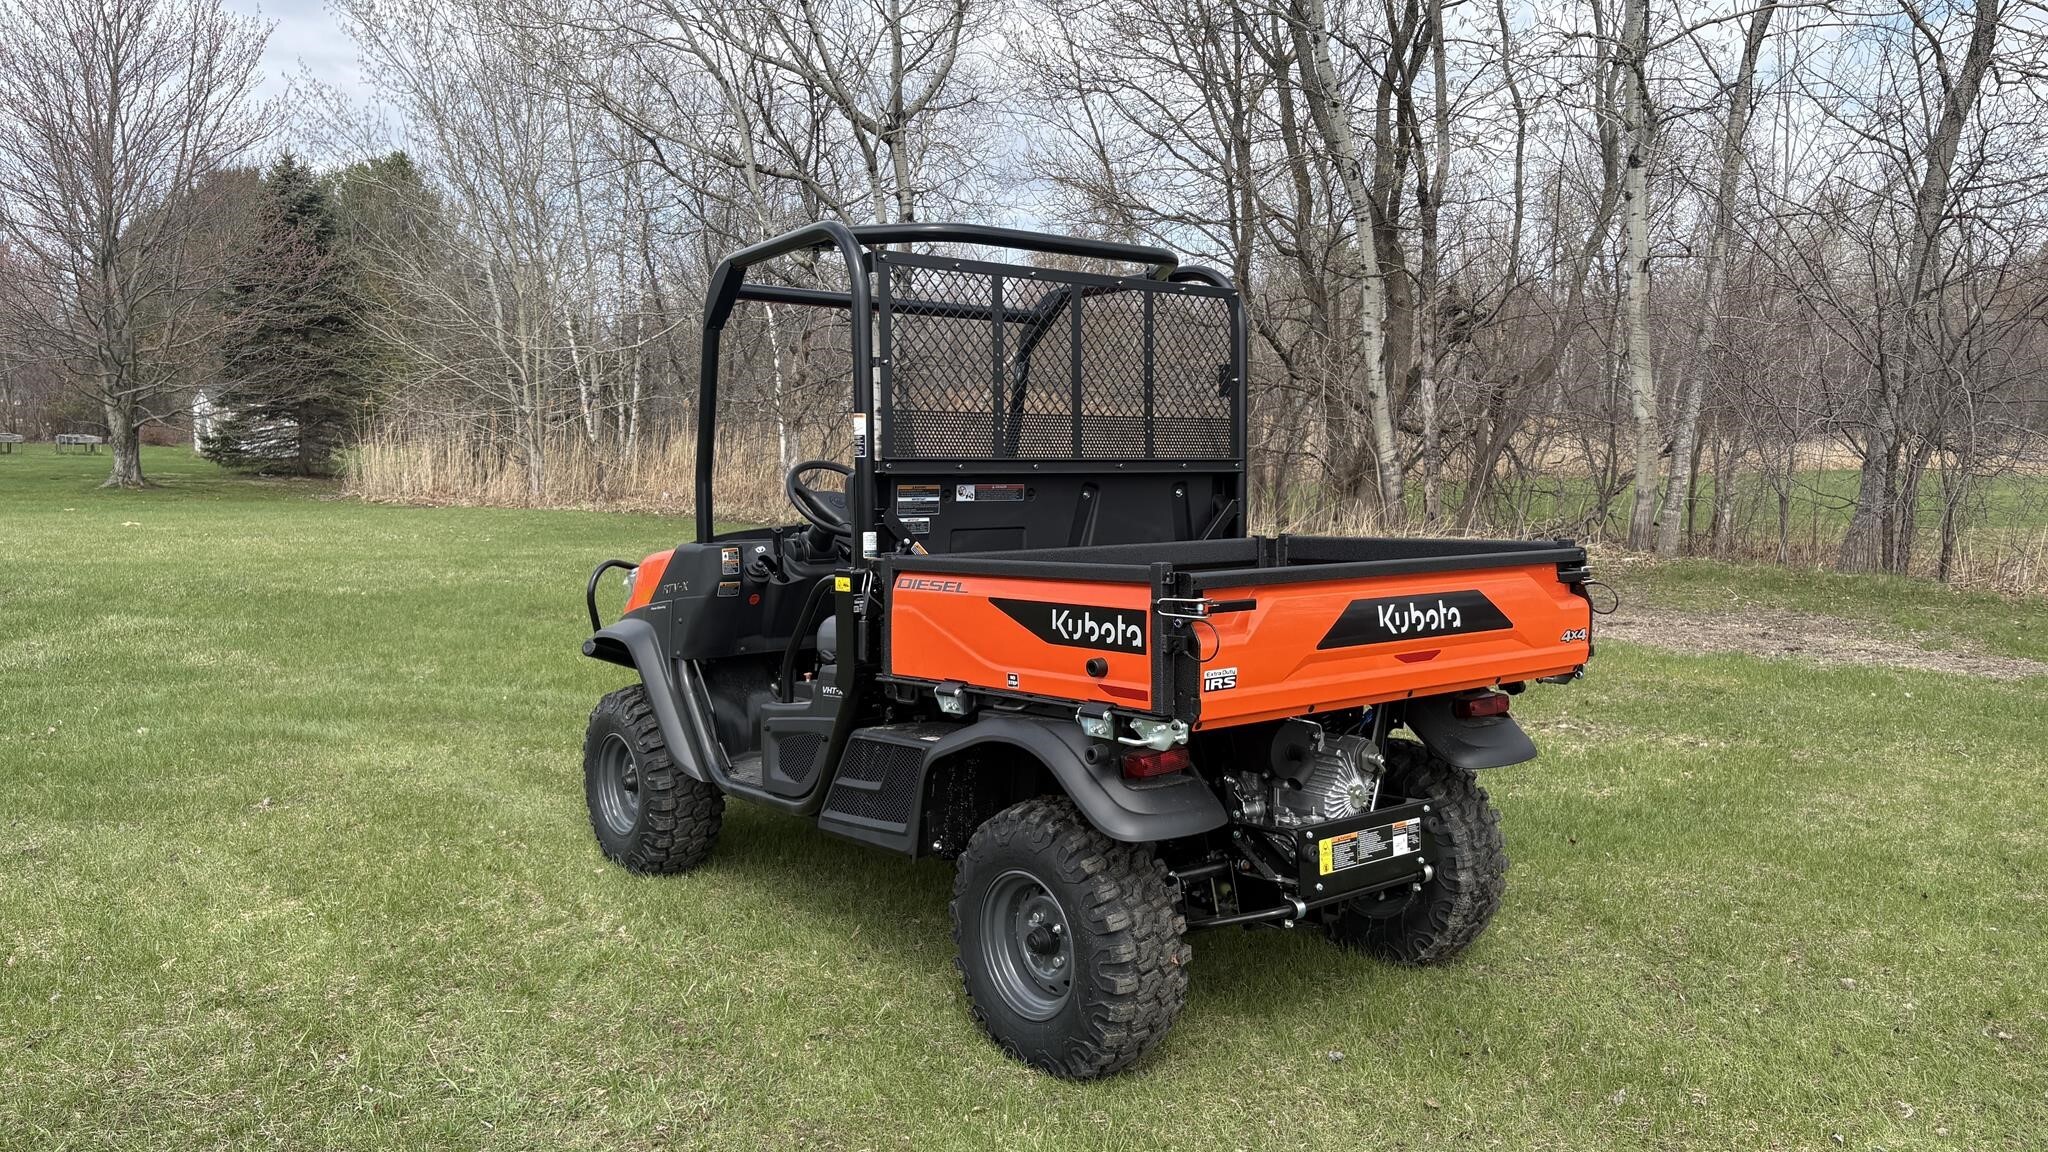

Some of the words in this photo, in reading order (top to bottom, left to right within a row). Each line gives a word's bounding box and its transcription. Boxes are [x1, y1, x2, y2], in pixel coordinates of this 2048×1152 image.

[897, 578, 969, 593] DIESEL
[1377, 599, 1461, 634] Kubota
[1051, 608, 1142, 648] Kubota
[1560, 628, 1587, 643] 4x4
[1222, 669, 1236, 677] Duty
[1204, 676, 1236, 691] IRS
